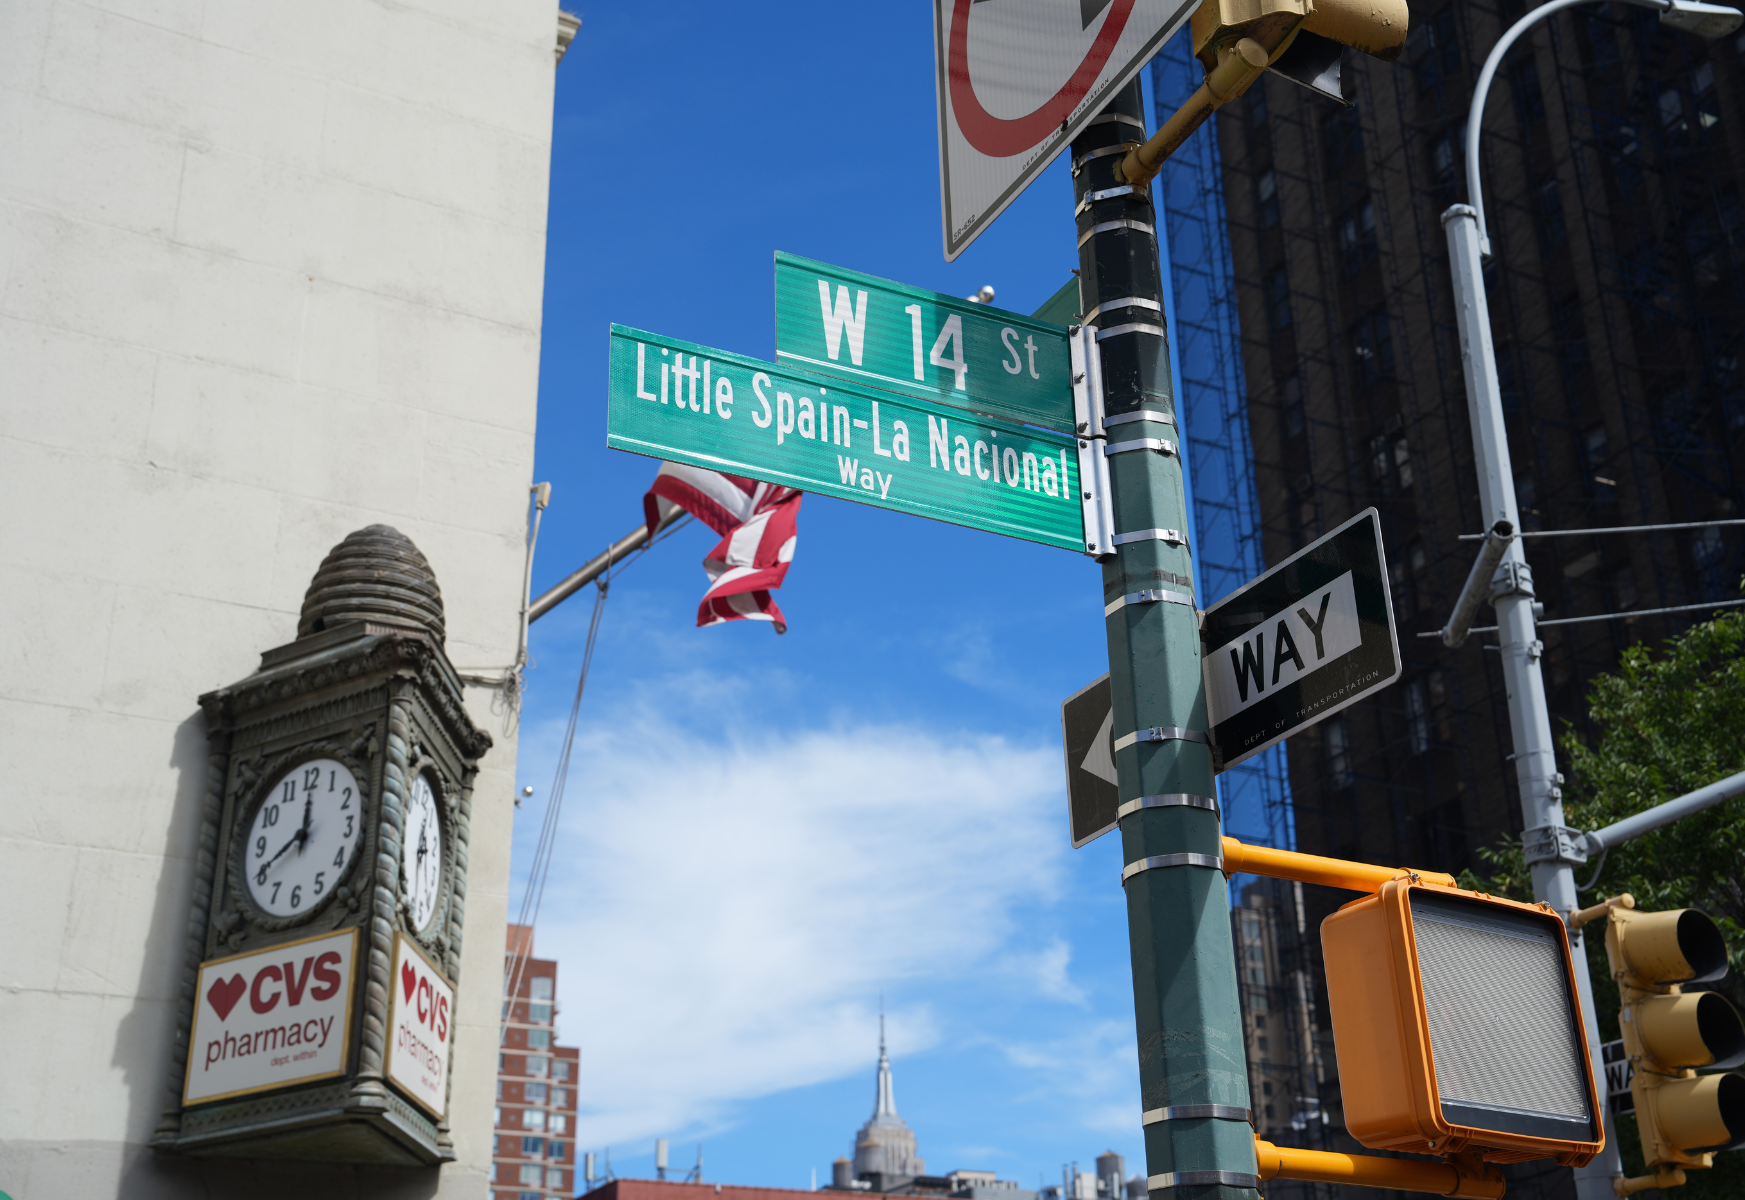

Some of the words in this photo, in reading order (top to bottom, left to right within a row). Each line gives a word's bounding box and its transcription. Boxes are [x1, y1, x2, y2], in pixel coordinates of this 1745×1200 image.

[1022, 152, 1038, 171] DEPT
[1041, 140, 1049, 151] OF
[1052, 77, 1109, 140] TRSPORTATION
[817, 278, 868, 366] W
[904, 303, 968, 392] 14
[1001, 326, 1040, 380] St
[636, 341, 734, 420] Little
[751, 371, 911, 463] Spain-La
[928, 414, 1070, 500] Nacional
[836, 453, 893, 501] Way
[1230, 591, 1332, 704] WAY
[1244, 729, 1266, 746] DEPT
[1275, 718, 1286, 729] OF
[1295, 669, 1379, 718] TRANSPORTATION
[281, 780, 296, 803] 11
[302, 767, 320, 792] 12
[328, 770, 336, 793] 1
[340, 787, 352, 810] 2
[261, 804, 279, 829] 10
[343, 815, 354, 838] 3
[255, 836, 267, 859] 9
[332, 846, 345, 869] 4
[256, 863, 268, 886] 8
[314, 872, 325, 895] 5
[270, 881, 282, 905] 7
[290, 885, 301, 908] 6
[250, 951, 342, 1015] CVS
[417, 975, 449, 1043] CVS
[204, 1015, 335, 1072] pharmacy
[397, 1020, 444, 1087] pharmacy
[270, 1054, 291, 1067] dept.
[293, 1049, 318, 1062] within
